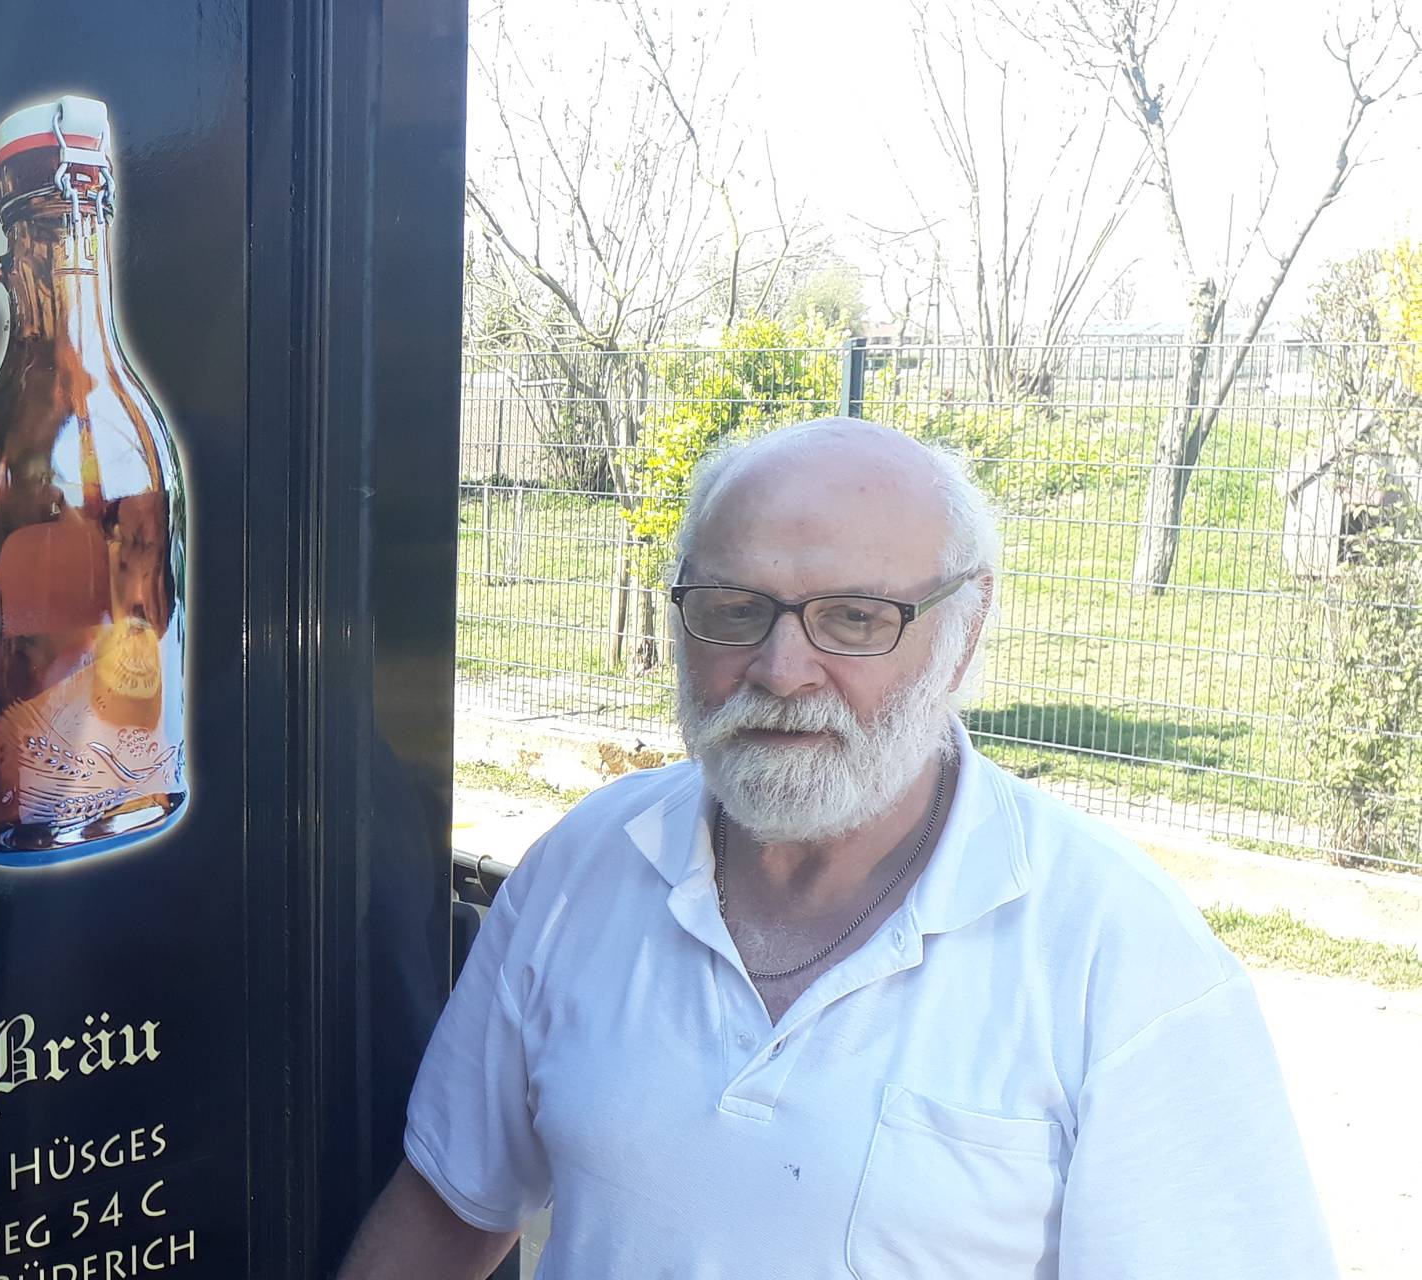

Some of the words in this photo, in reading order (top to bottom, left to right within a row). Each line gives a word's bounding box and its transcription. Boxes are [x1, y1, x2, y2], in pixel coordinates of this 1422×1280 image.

[10, 1124, 167, 1191] HÜSGES
[72, 1191, 123, 1239] 54
[141, 1180, 166, 1217] C
